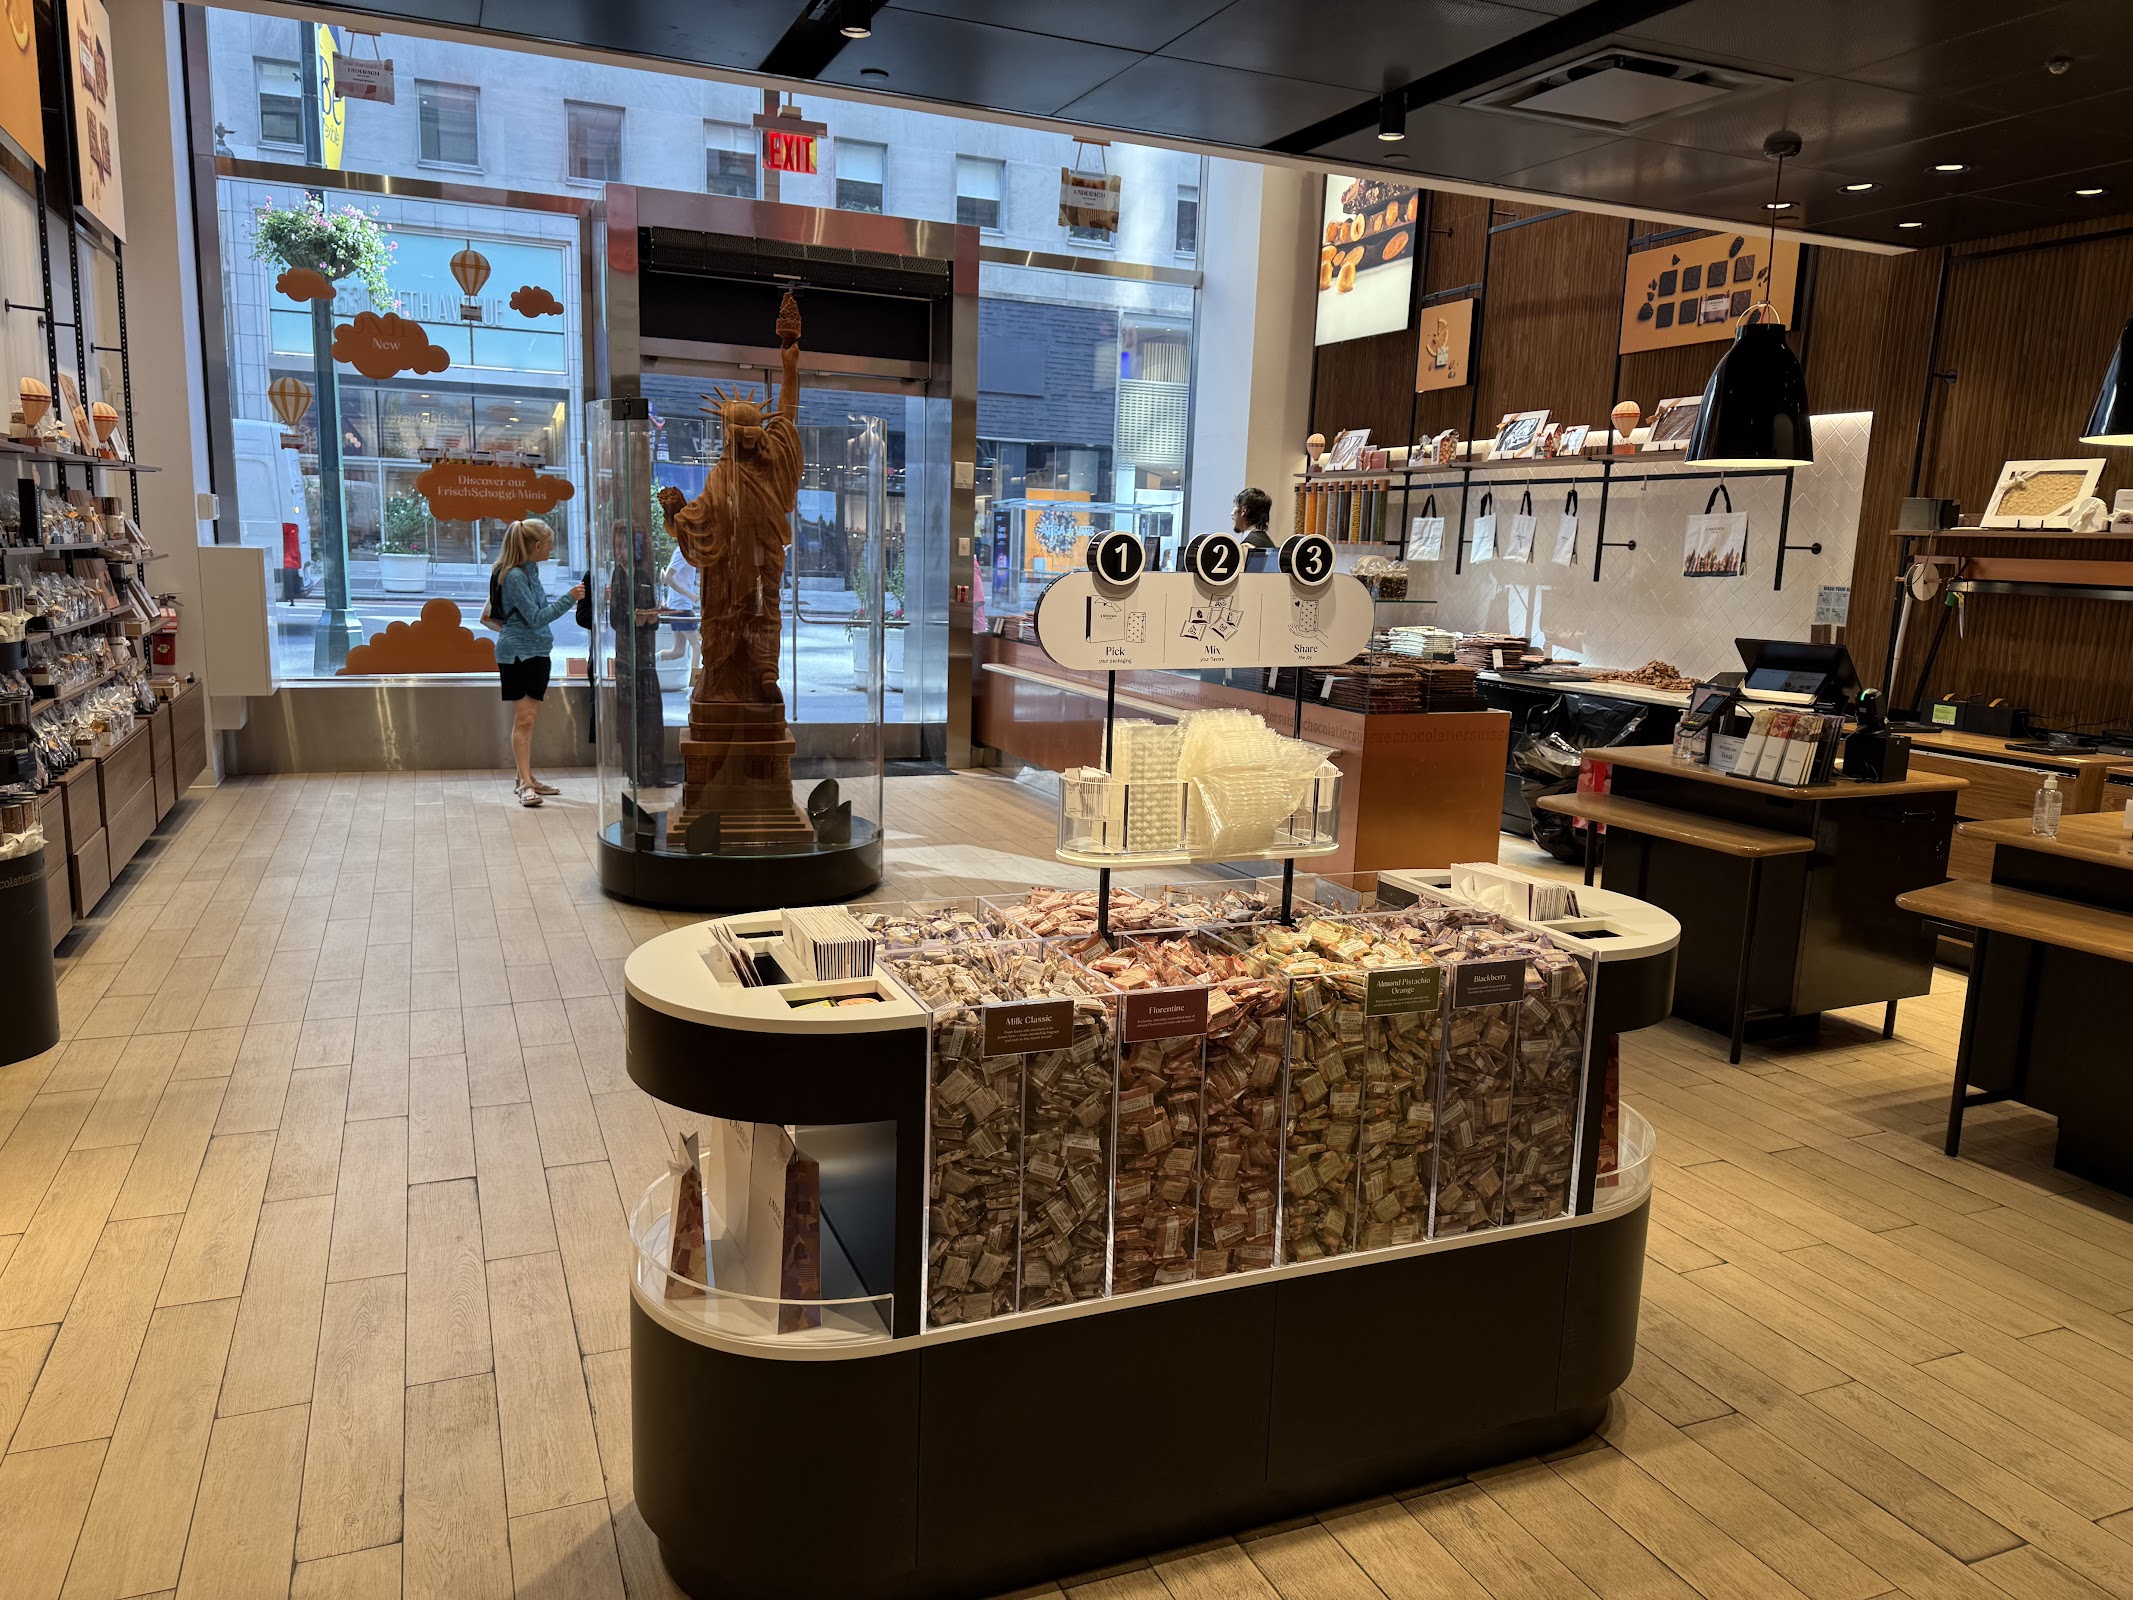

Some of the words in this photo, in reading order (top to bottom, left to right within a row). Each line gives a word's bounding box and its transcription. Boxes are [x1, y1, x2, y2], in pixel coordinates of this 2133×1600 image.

[769, 131, 814, 174] EXIT
[372, 336, 401, 350] New
[457, 474, 506, 487] Discover
[508, 478, 527, 488] our
[437, 486, 516, 501] FrischSchoggi
[517, 488, 548, 501] Minis
[1114, 542, 1129, 573] 1
[1210, 544, 1229, 574] 2
[1305, 545, 1323, 575] 3
[1105, 646, 1126, 656] Pick
[1204, 645, 1222, 655] Mix
[1293, 643, 1319, 654] Share
[1376, 978, 1401, 988] Almond
[1401, 976, 1431, 986] Pistachio
[1474, 974, 1507, 983] Blackberry
[1391, 987, 1415, 995] Orange
[1148, 1004, 1185, 1015] Florentine
[1005, 1017, 1023, 1026] Milk
[1024, 1014, 1053, 1025] Classic
